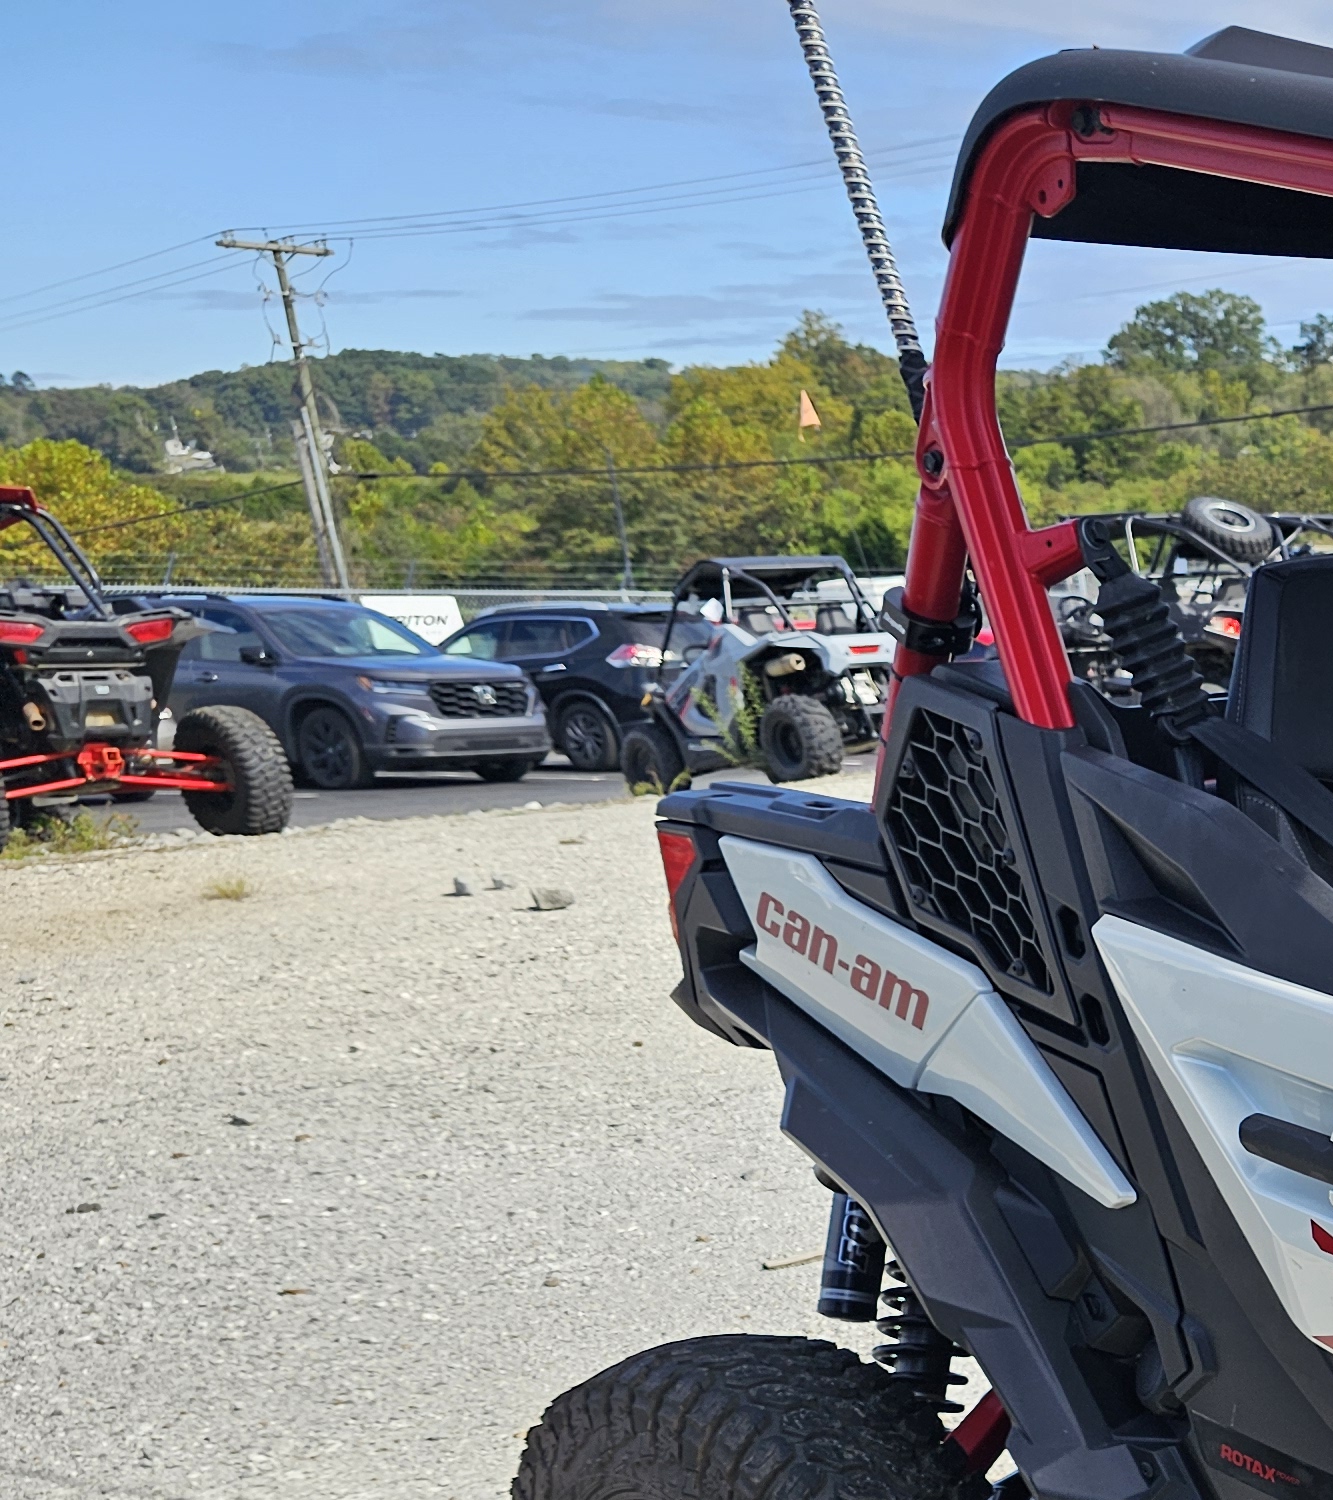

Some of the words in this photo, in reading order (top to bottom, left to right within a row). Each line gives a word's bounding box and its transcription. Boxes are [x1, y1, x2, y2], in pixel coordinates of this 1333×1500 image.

[388, 614, 449, 626] RITON
[756, 891, 930, 1030] can-am
[1220, 1443, 1276, 1483] ROTAX
